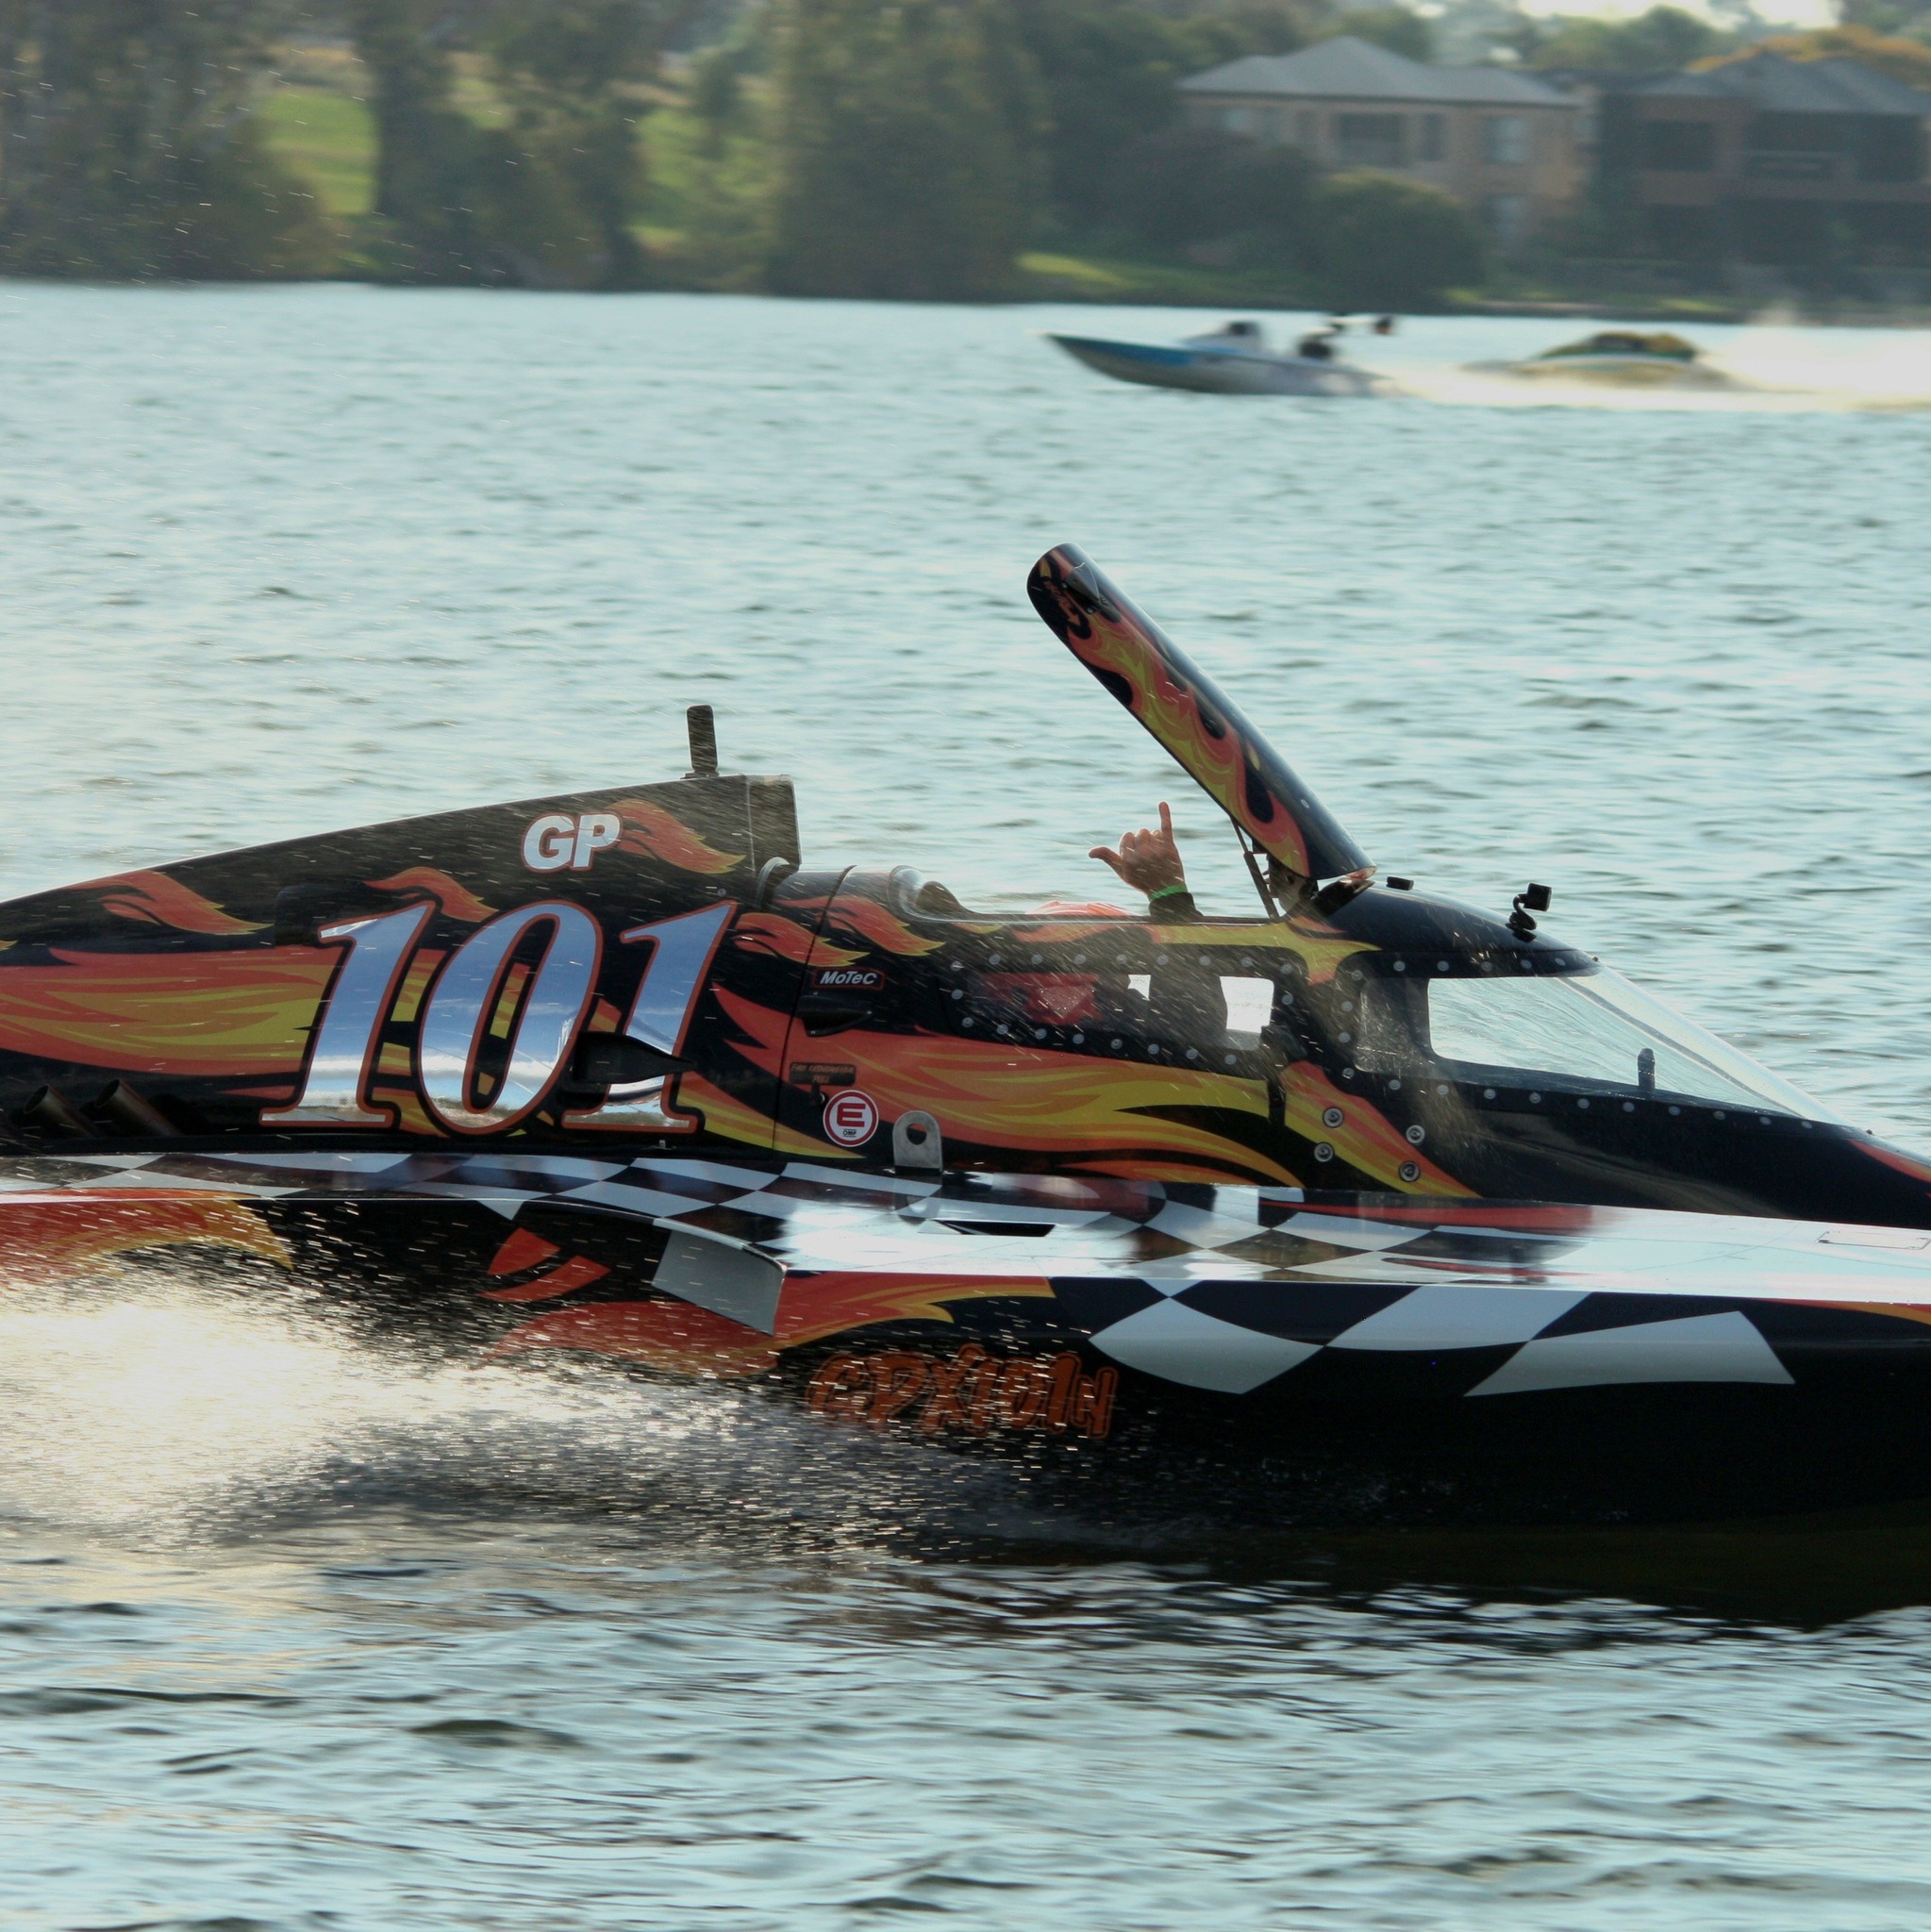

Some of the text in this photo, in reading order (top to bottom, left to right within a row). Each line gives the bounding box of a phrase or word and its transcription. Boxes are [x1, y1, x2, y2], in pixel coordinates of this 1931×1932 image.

[522, 813, 622, 872] GP
[819, 970, 878, 985] MoTeC
[260, 899, 738, 1135] 101
[836, 1102, 866, 1128] E
